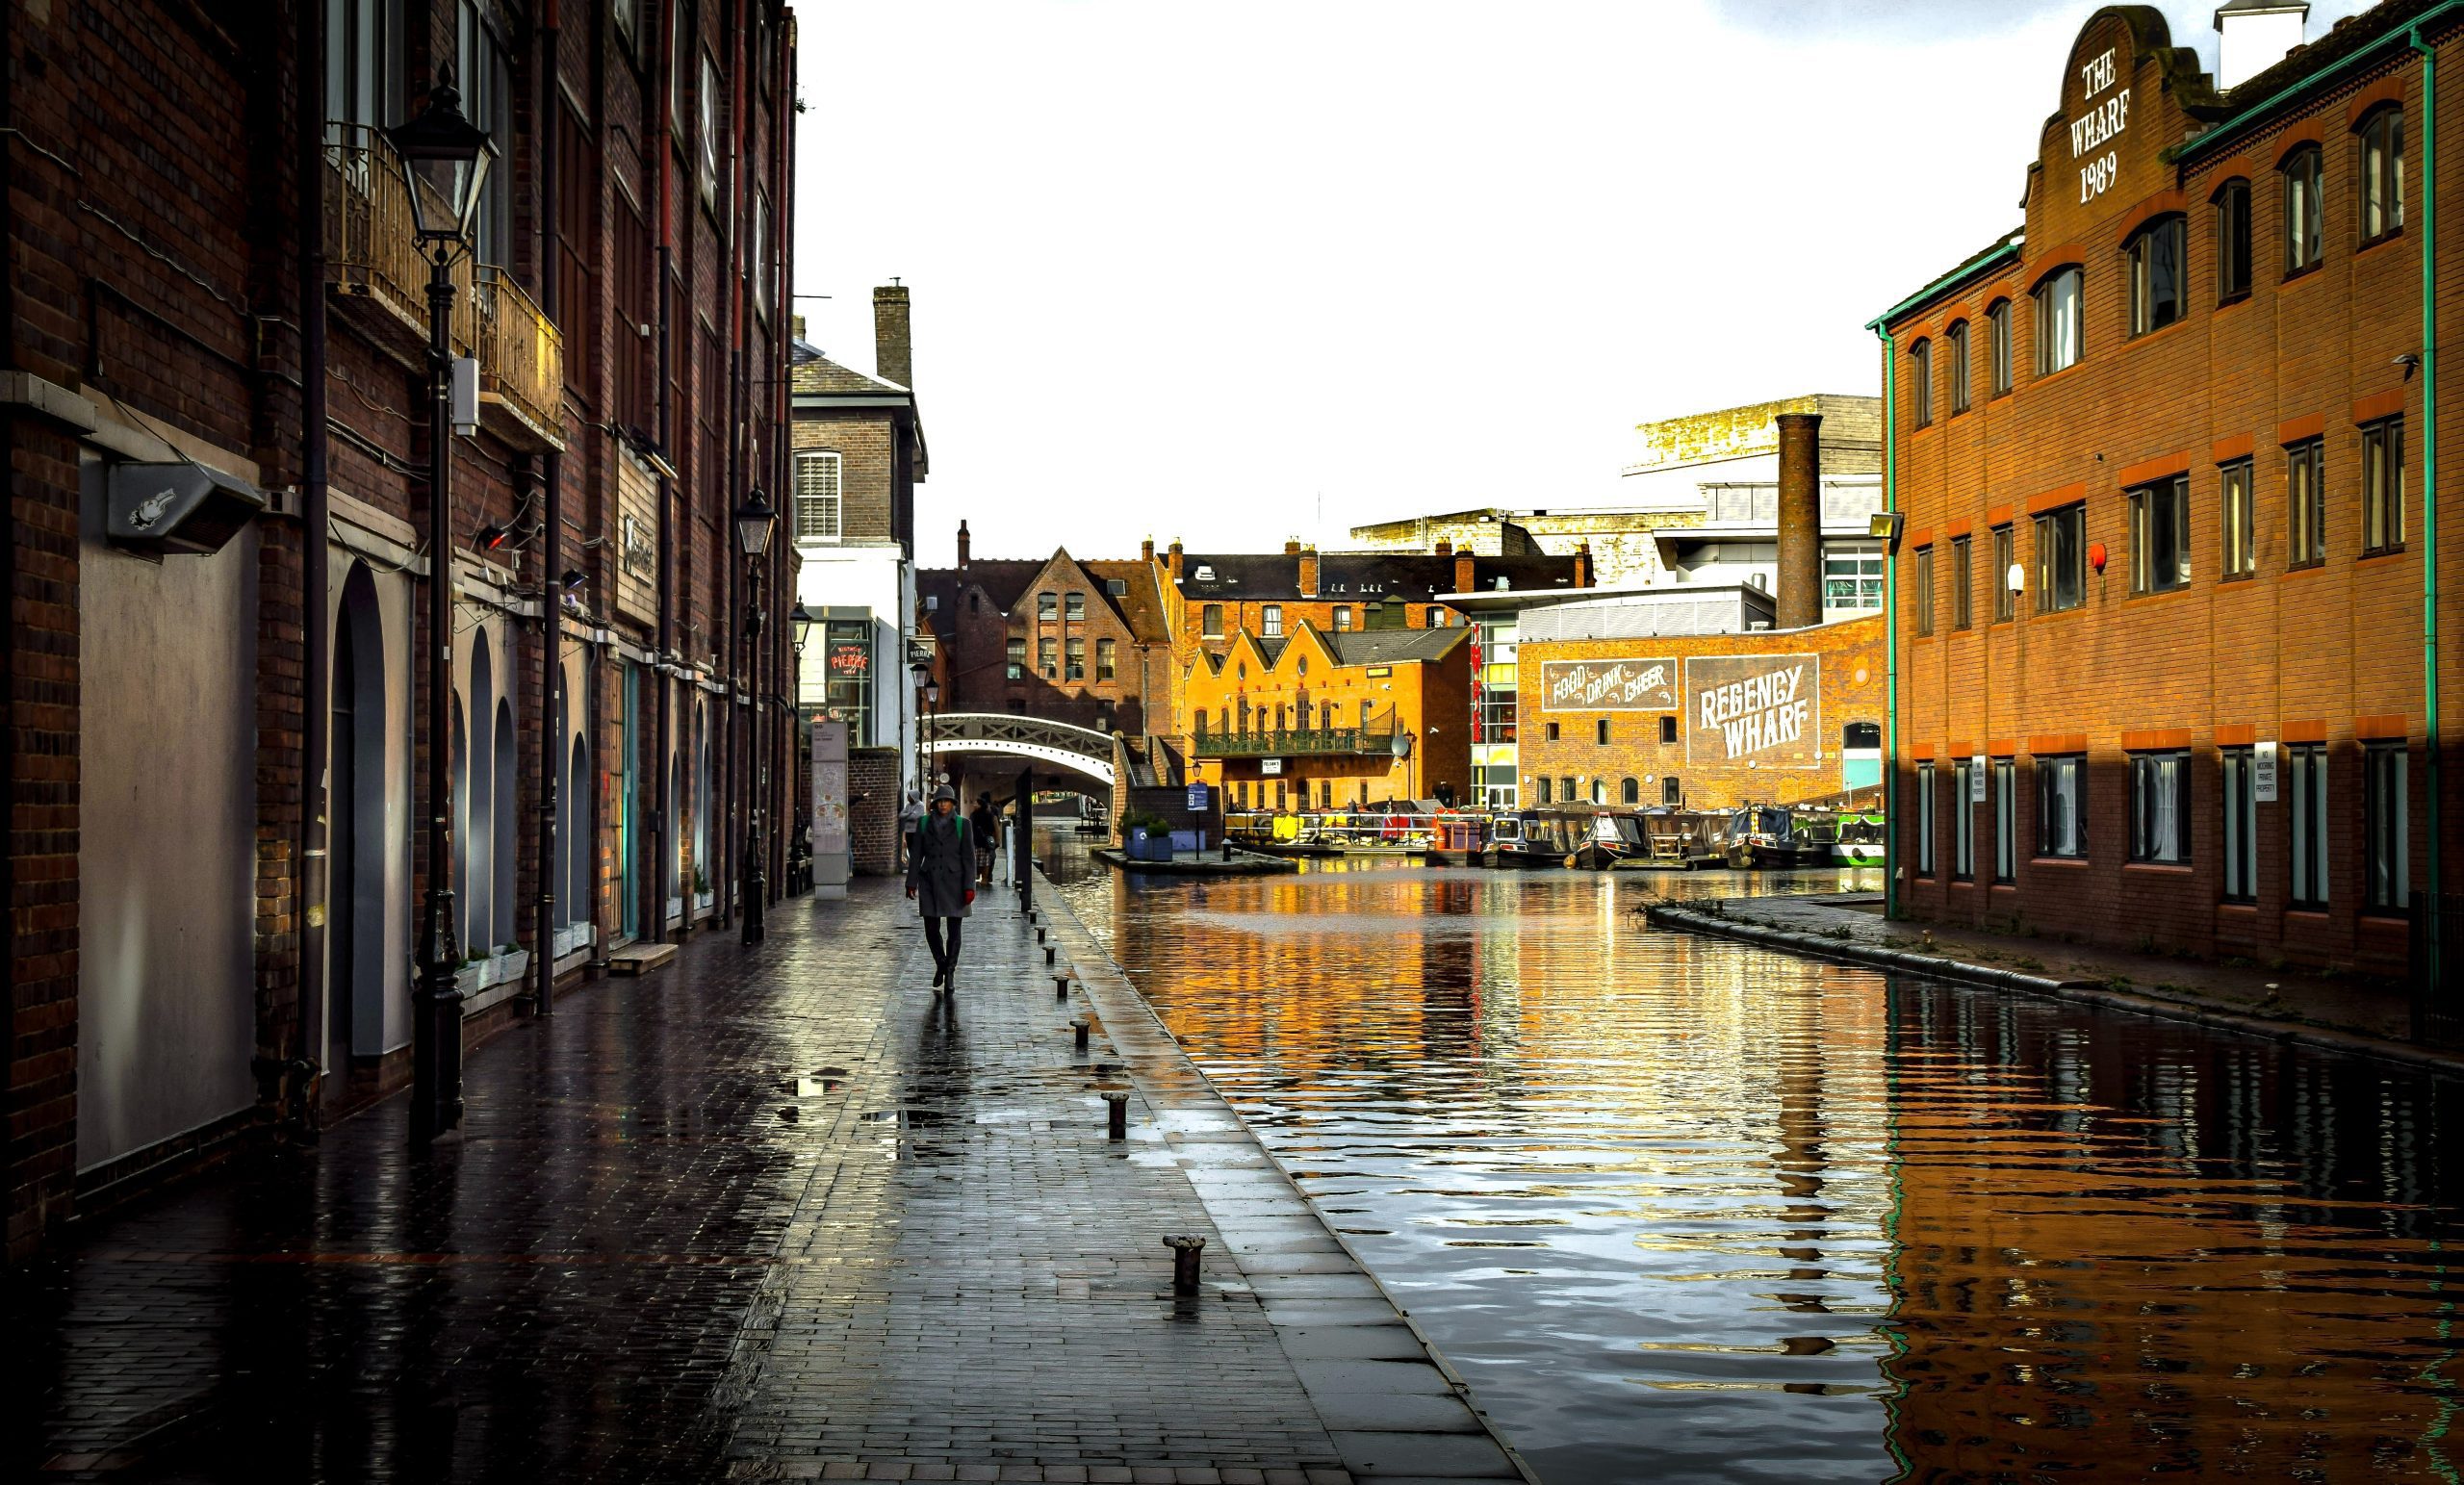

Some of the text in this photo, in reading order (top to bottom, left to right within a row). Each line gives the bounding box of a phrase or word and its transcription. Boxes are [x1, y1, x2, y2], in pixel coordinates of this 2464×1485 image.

[2081, 47, 2117, 100] THE
[2070, 88, 2130, 159] WHARF
[2080, 150, 2117, 204] 1989
[831, 654, 869, 671] PIERRE
[910, 650, 932, 658] PIERRE
[1553, 664, 1667, 704] FOOD DRINK CHEER
[1700, 665, 1803, 730] REGENCY
[1723, 699, 1809, 760] WHARF
